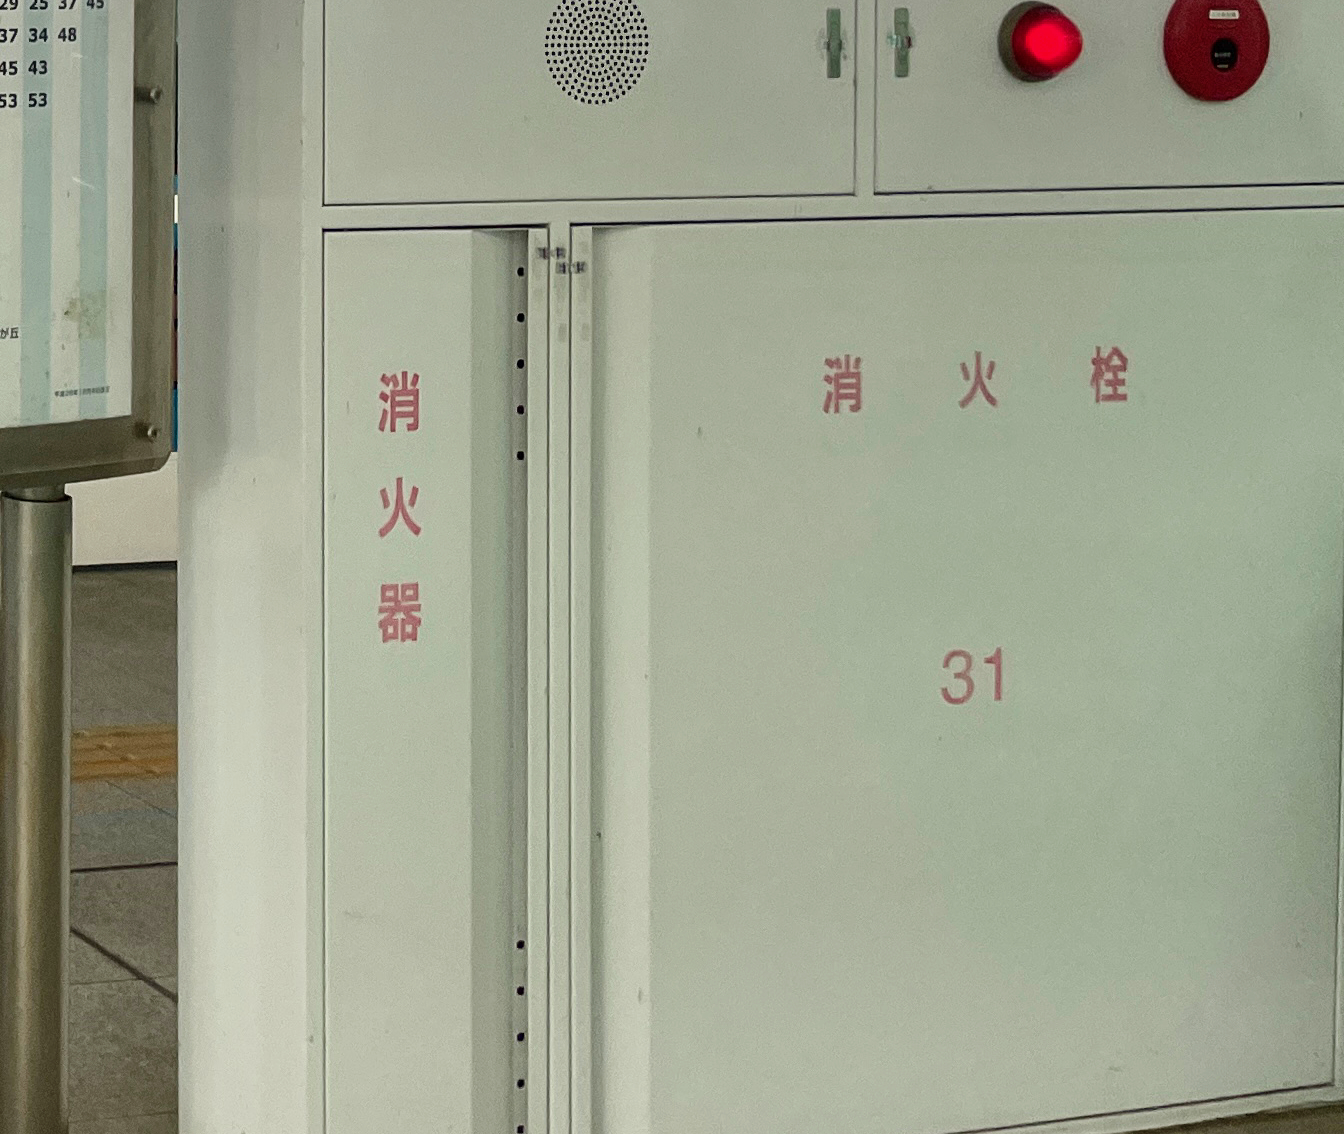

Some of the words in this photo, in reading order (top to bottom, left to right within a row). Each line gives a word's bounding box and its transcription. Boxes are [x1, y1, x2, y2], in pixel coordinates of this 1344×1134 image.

[822, 346, 1130, 415] 消火栓
[377, 371, 423, 645] 消火器
[939, 647, 1007, 706] 31
